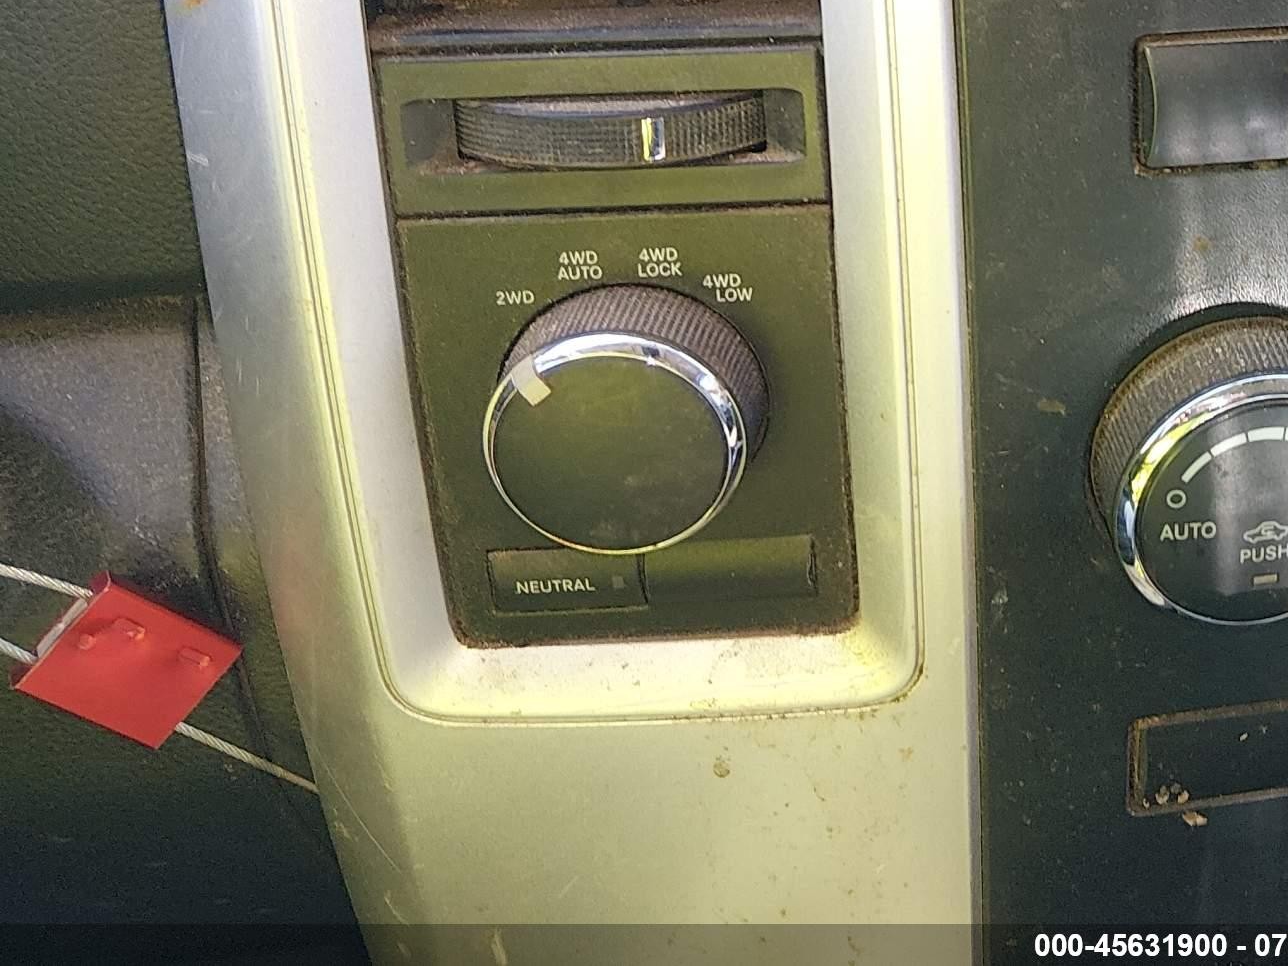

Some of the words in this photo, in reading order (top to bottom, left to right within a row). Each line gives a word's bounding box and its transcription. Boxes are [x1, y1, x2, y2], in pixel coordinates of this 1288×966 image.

[559, 250, 598, 265] 4WD
[639, 247, 678, 263] 4WD
[557, 265, 602, 281] AUTO
[638, 262, 682, 278] LOCK
[703, 273, 741, 288] 4WD
[496, 290, 535, 306] 2WD
[716, 287, 753, 302] LOW
[1159, 521, 1217, 542] AUTO
[515, 578, 595, 595] NEUTRAL
